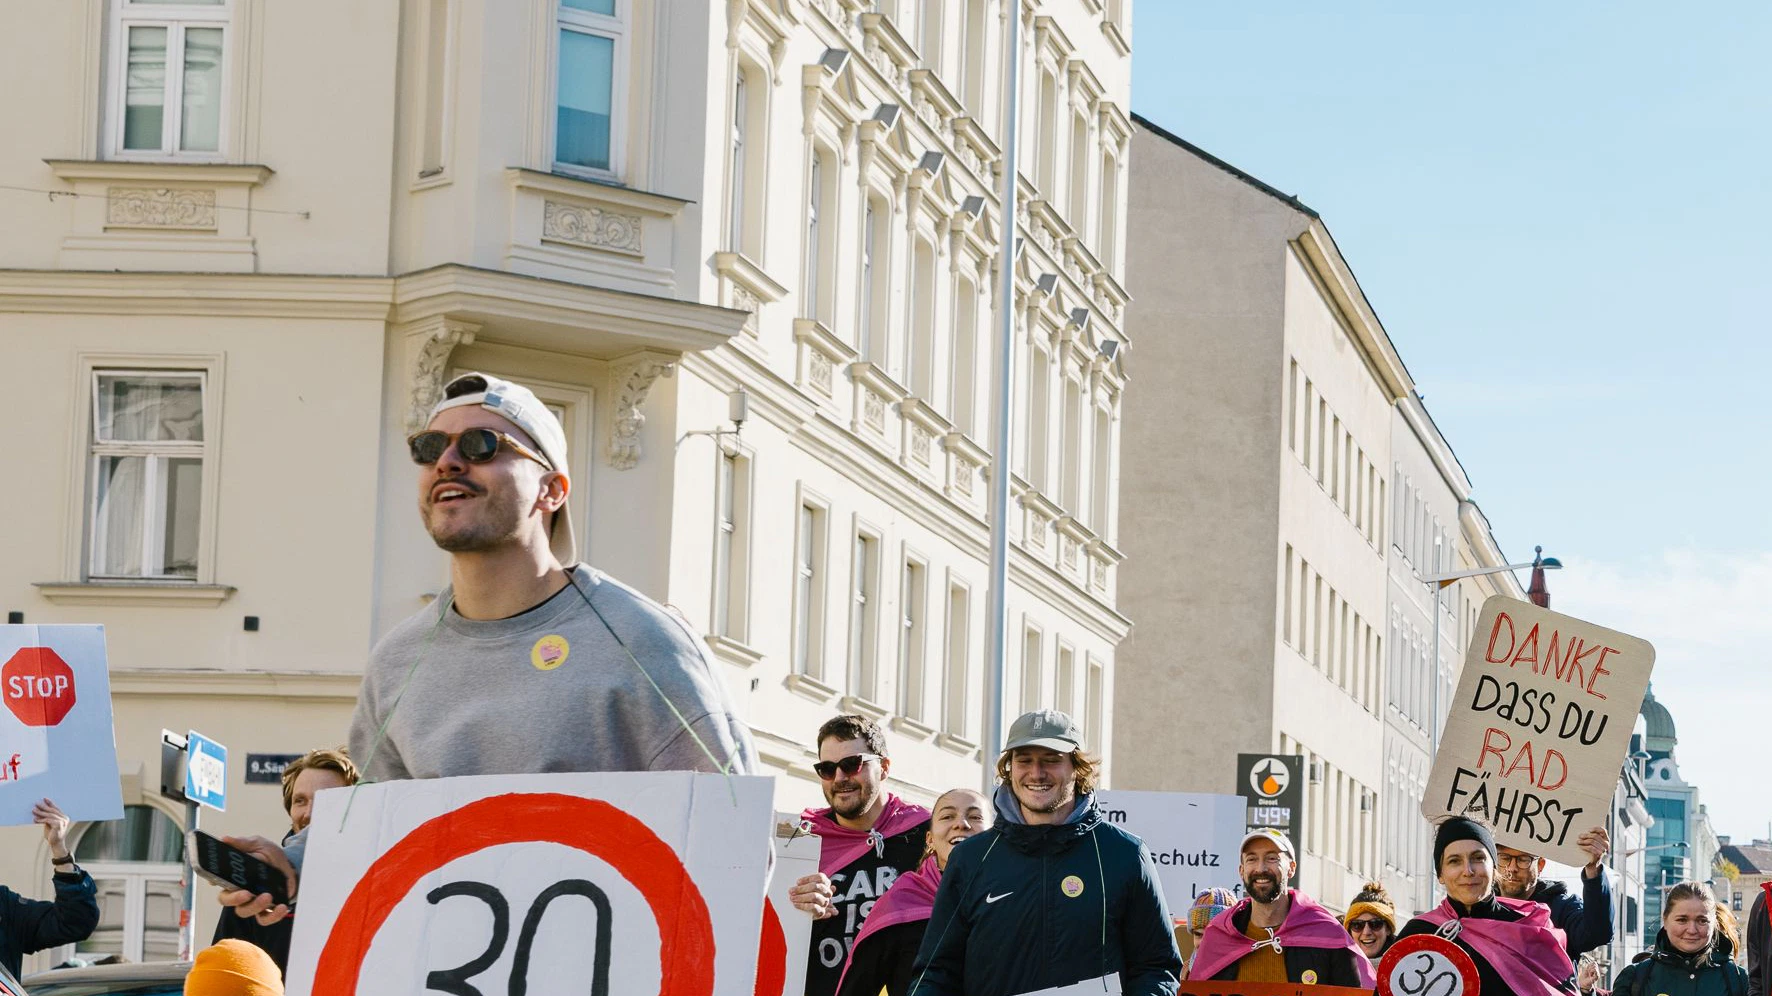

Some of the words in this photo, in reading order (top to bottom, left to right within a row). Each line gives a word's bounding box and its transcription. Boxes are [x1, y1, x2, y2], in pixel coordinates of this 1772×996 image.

[1485, 611, 1621, 700] DANKE
[8, 674, 69, 699] STOP
[1558, 701, 1609, 746] DU
[1476, 727, 1568, 791] RAD
[1099, 809, 1127, 823] rm
[1446, 767, 1584, 846] FÄHRST
[830, 866, 899, 904] CAR
